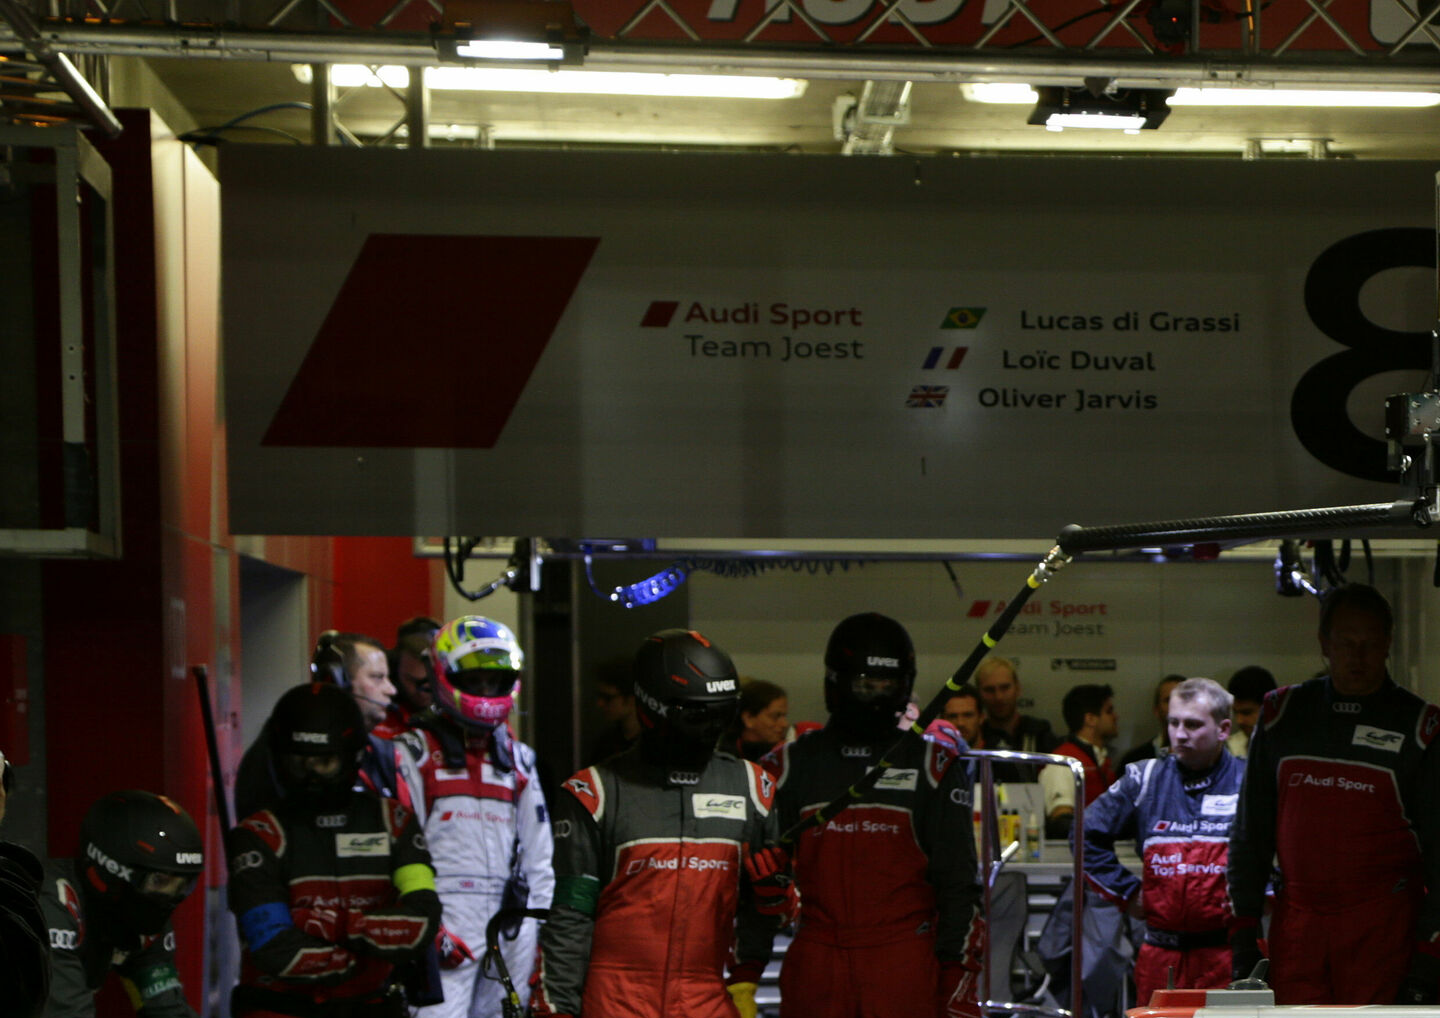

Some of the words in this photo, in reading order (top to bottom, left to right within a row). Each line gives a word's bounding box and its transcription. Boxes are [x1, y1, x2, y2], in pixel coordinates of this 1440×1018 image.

[685, 302, 759, 324] Audi
[770, 303, 863, 330] Sport
[1021, 310, 1104, 331] Lucas
[1113, 312, 1139, 331] di
[1150, 312, 1241, 332] Grassi
[684, 335, 771, 358] Team
[782, 336, 864, 361] Joest
[1003, 350, 1061, 370] Loïc
[1072, 350, 1156, 371] Duval
[978, 388, 1067, 409] Oliver
[1075, 388, 1159, 412] Jarvis
[1050, 602, 1108, 616] Sport
[1056, 621, 1104, 636] Joest
[867, 656, 899, 668] uvex
[706, 679, 736, 693] uvex
[1304, 774, 1333, 787] Audi
[1337, 776, 1376, 794] Sport
[826, 820, 859, 833] Audi
[862, 820, 900, 835] Sport
[1170, 820, 1199, 832] Audi
[86, 842, 134, 883] uvex
[647, 857, 686, 870] Audi
[689, 857, 730, 871] Sport
[1150, 853, 1182, 865] Audi
[1151, 865, 1175, 876] Top
